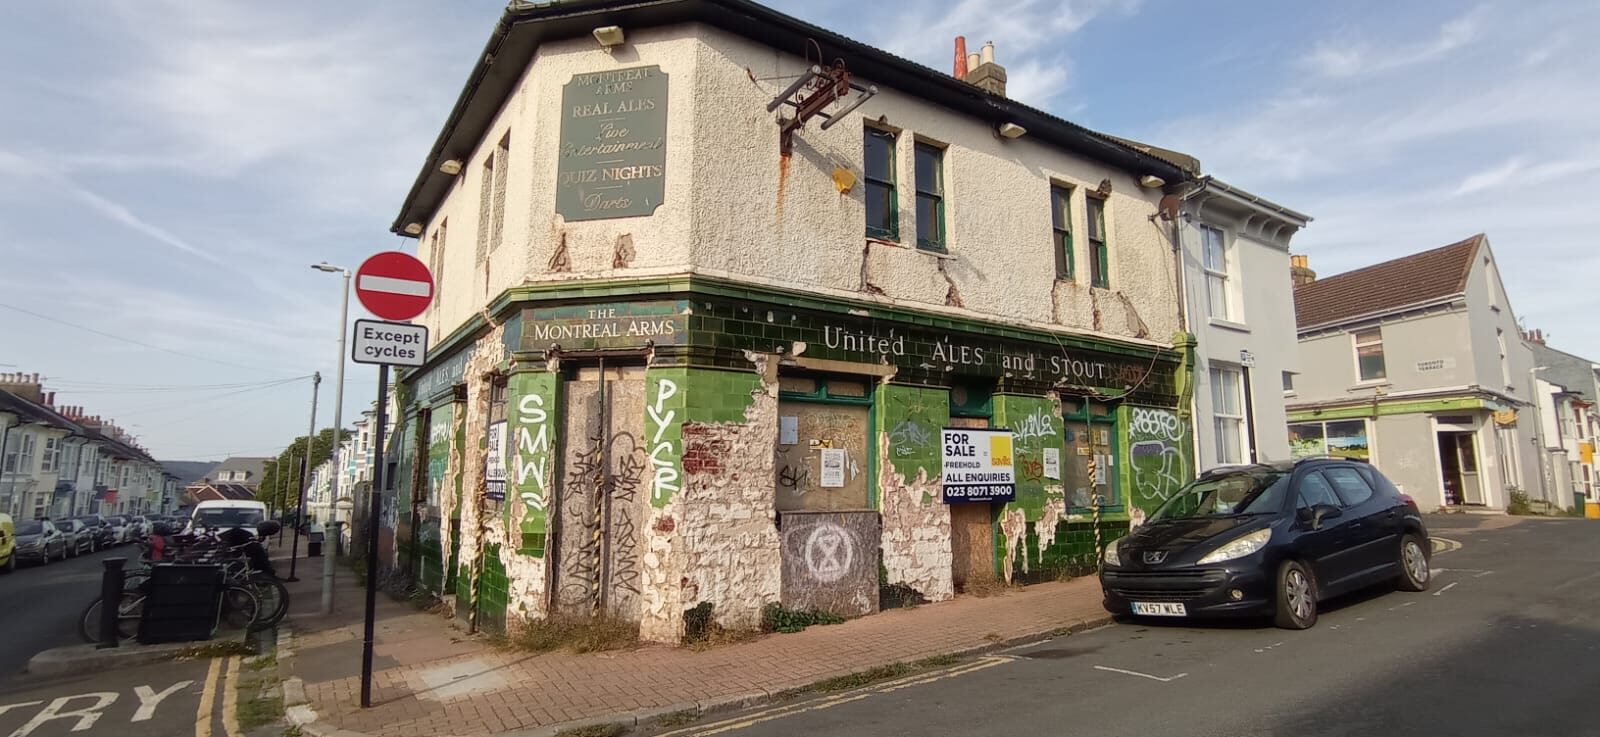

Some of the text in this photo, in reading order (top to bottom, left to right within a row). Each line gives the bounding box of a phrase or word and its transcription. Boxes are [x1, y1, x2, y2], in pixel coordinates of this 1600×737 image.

[572, 98, 655, 117] REAL ALES
[595, 123, 630, 141] Live
[560, 164, 663, 187] QUIZ NIGHTS
[583, 192, 633, 212] Darts
[588, 308, 616, 319] THE
[364, 327, 420, 345] Except
[534, 319, 674, 340] MONTREAL ARMS
[364, 345, 416, 359] cycles
[824, 325, 904, 356] United
[932, 340, 984, 366] ALES
[1002, 353, 1034, 371] and
[1051, 355, 1105, 380] STOUT
[944, 433, 969, 444] FOR
[945, 445, 976, 457] SALE
[945, 473, 1011, 482] ALL ENQUIRIES
[946, 485, 1012, 497] 023 8071 3900
